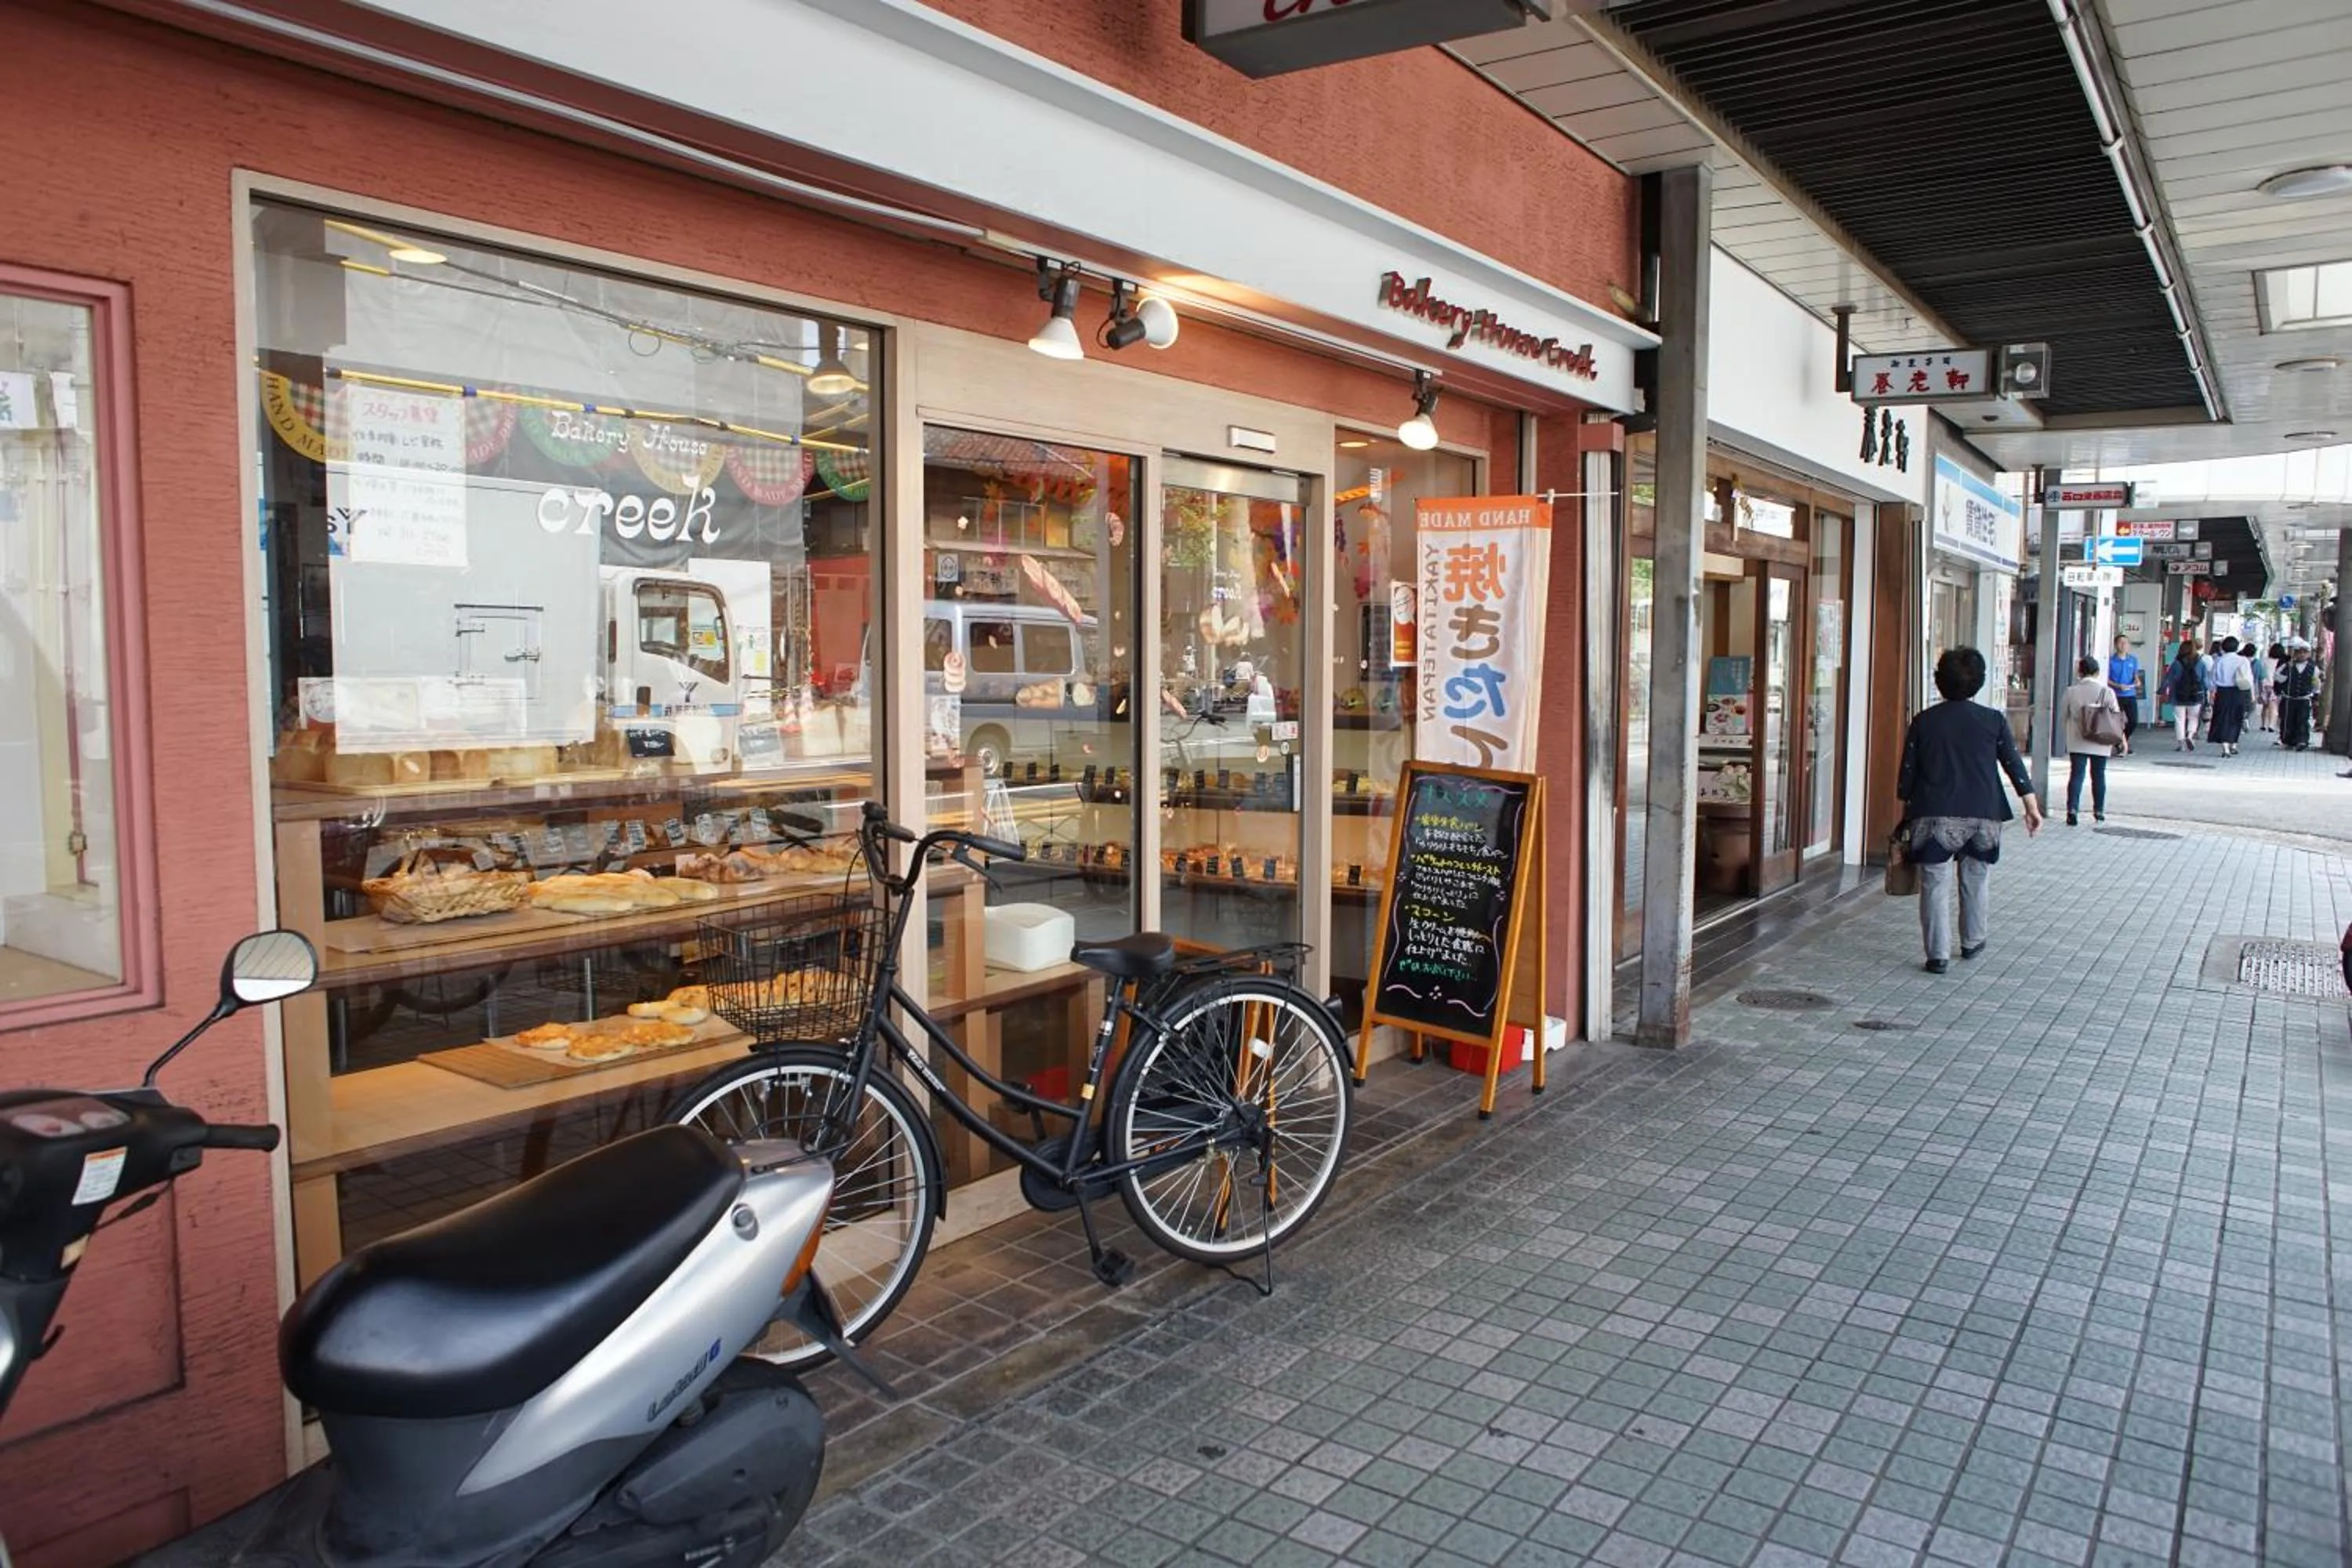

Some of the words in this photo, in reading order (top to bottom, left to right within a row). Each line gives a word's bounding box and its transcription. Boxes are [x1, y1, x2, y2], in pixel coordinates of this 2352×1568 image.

[1379, 270, 1473, 349] Bakery
[267, 376, 295, 431] HAND
[1870, 367, 1970, 394] 養老軒
[550, 409, 630, 453] Bakery
[537, 473, 721, 545] creek
[2067, 572, 2118, 583] 自転車除
